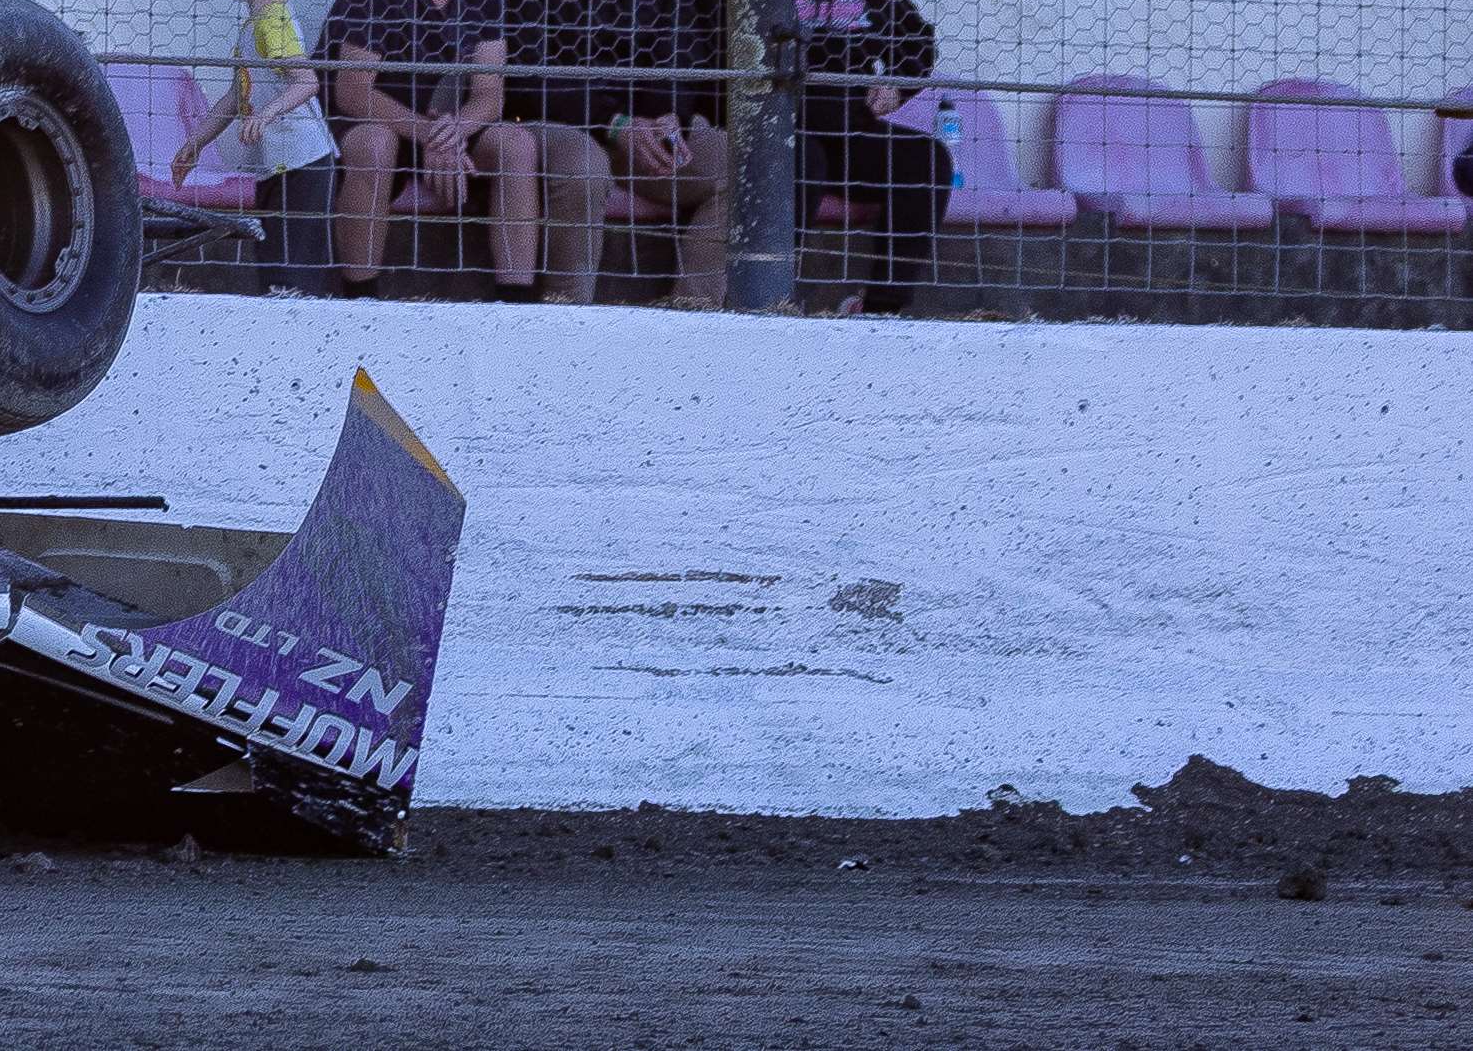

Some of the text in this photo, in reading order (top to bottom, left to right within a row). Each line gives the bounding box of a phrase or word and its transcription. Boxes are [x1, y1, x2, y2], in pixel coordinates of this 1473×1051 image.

[65, 622, 421, 790] MUFFLERS
[214, 610, 415, 716] NZ LTD
